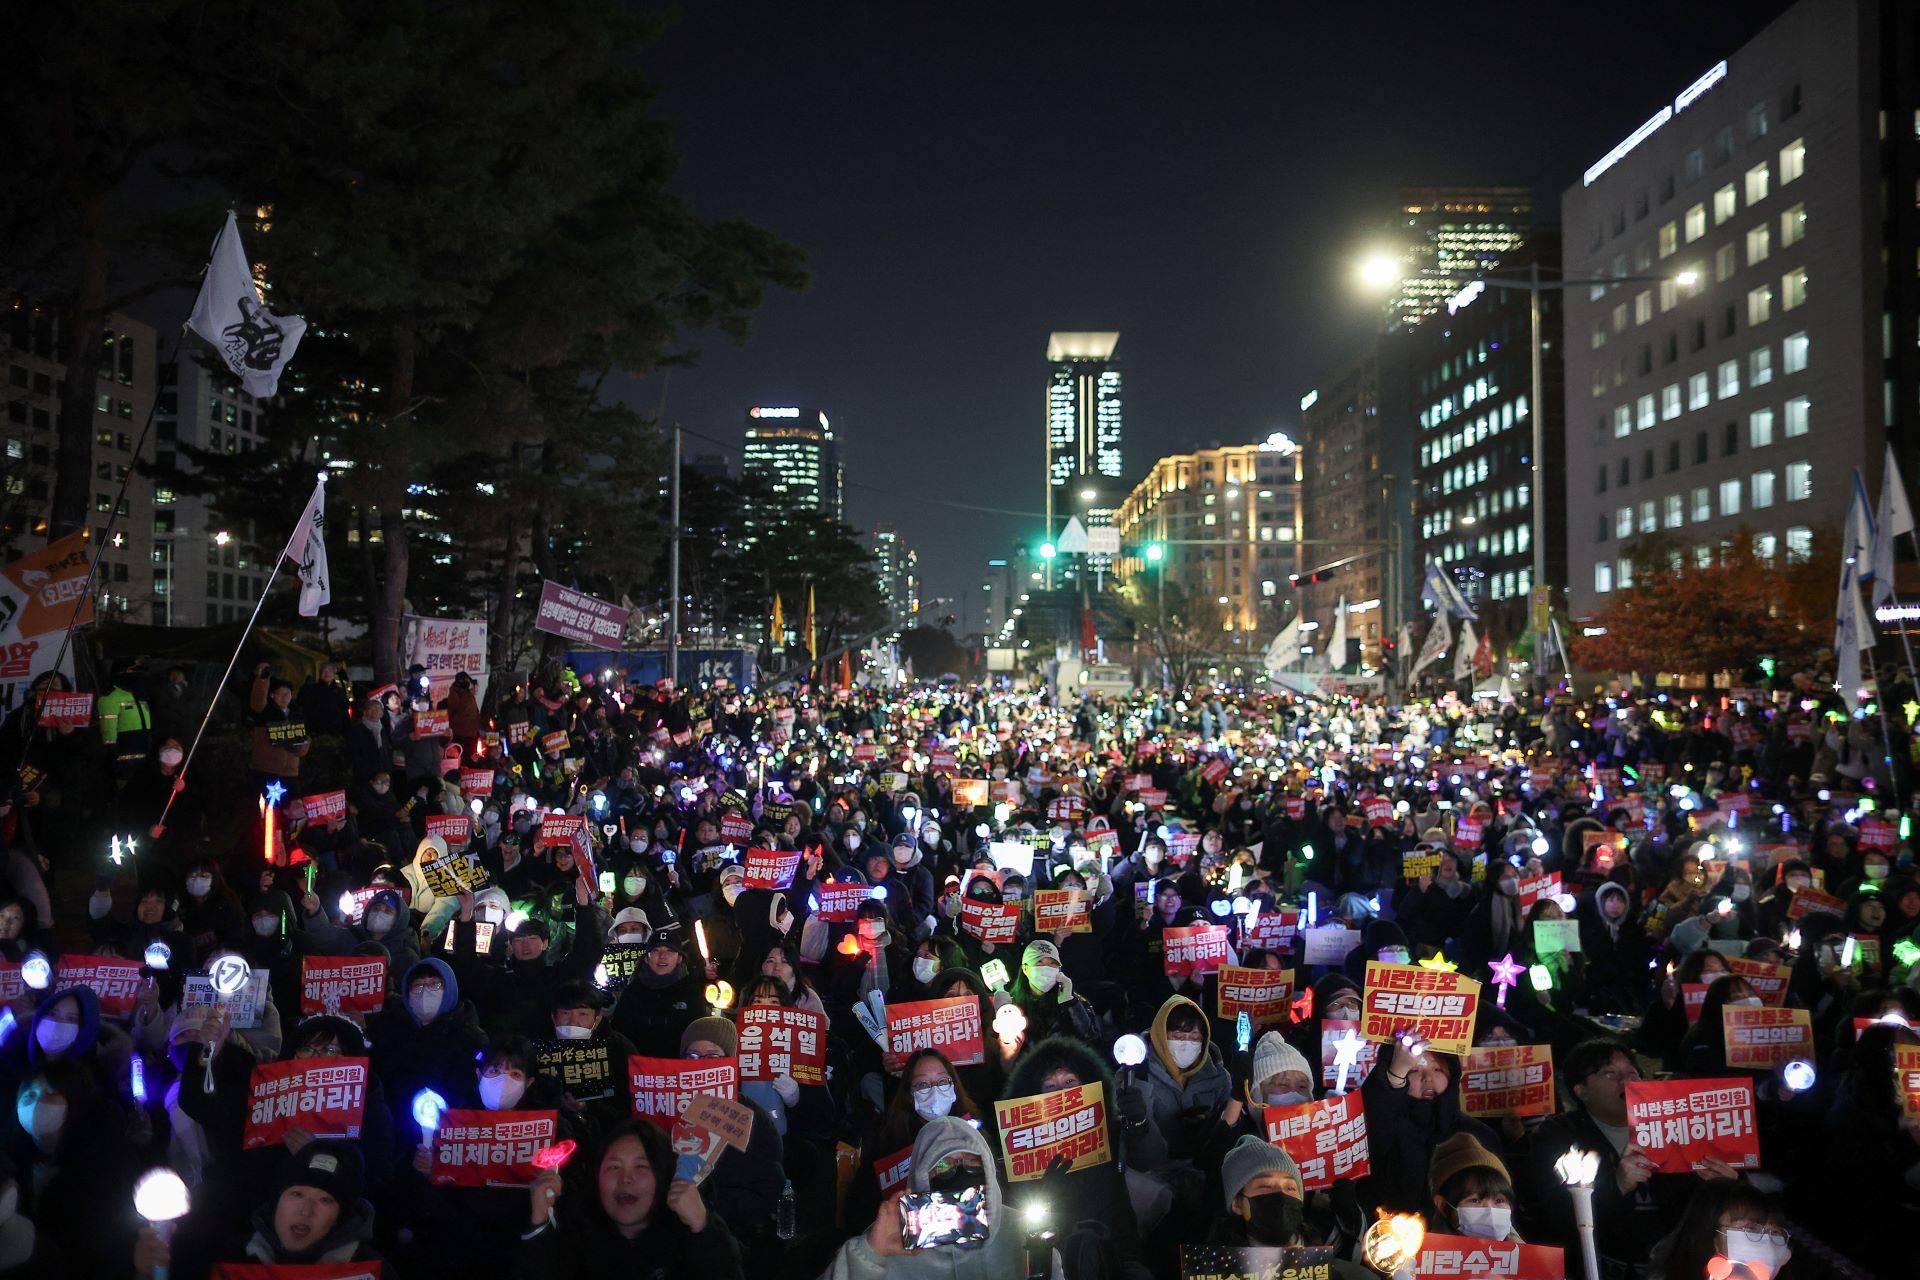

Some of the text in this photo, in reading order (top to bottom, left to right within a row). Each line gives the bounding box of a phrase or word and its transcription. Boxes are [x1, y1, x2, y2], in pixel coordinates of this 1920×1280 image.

[1167, 944, 1226, 964] 해체하라!
[343, 963, 381, 977] 국민의힘
[1366, 968, 1459, 991] 내란동조
[1224, 985, 1286, 1002] 국민의힘
[1375, 992, 1465, 1015] 국민의힘
[744, 1009, 817, 1028] 반민주 반헌법
[891, 1003, 976, 1030] 내란동조 국민의힘
[1367, 1015, 1469, 1040] 해체하라!
[740, 1027, 817, 1056] 윤석열
[892, 1018, 979, 1053] 해체하라!
[1734, 1026, 1802, 1043] 국민의힘
[575, 1047, 607, 1060] 윤석열
[738, 1053, 790, 1077] 탄핵
[254, 1067, 361, 1096] 내란동조 국민의힘
[564, 1061, 609, 1084] 탄핵!
[633, 1069, 731, 1089] 내란동조 국민의힘
[1467, 1065, 1543, 1090] 국민의힘
[251, 1085, 361, 1125] 해체하라!
[1000, 1086, 1083, 1129] 내란동조
[1633, 1090, 1745, 1118] 내란동조 국민의힘
[440, 1121, 551, 1141] 내란동조 국민의힘
[1013, 1106, 1095, 1149] 국민의힘
[1269, 1097, 1347, 1142] 내란수괴
[1635, 1110, 1752, 1148] 해체하라!
[1316, 1112, 1367, 1155] 윤석열
[1012, 1127, 1103, 1176] 해체하라!
[1333, 1136, 1369, 1175] 탄핵!
[1416, 1244, 1519, 1275] 내란수괴
